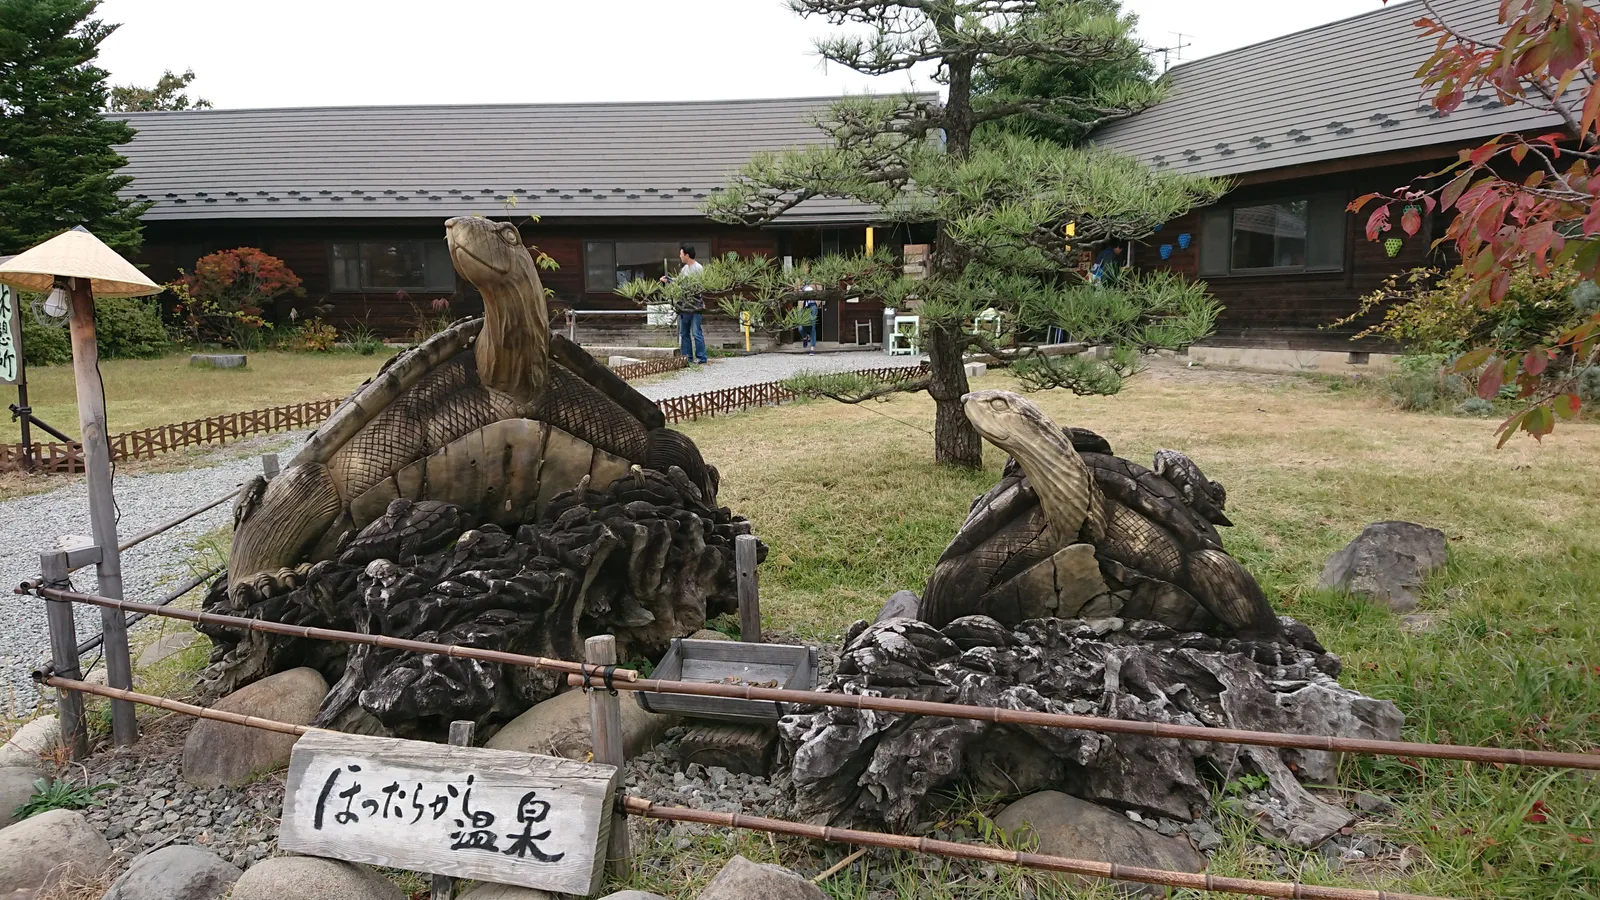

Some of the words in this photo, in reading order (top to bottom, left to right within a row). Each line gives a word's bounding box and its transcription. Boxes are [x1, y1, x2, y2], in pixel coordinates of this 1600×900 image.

[314, 764, 565, 863] ほったらかし温泉
